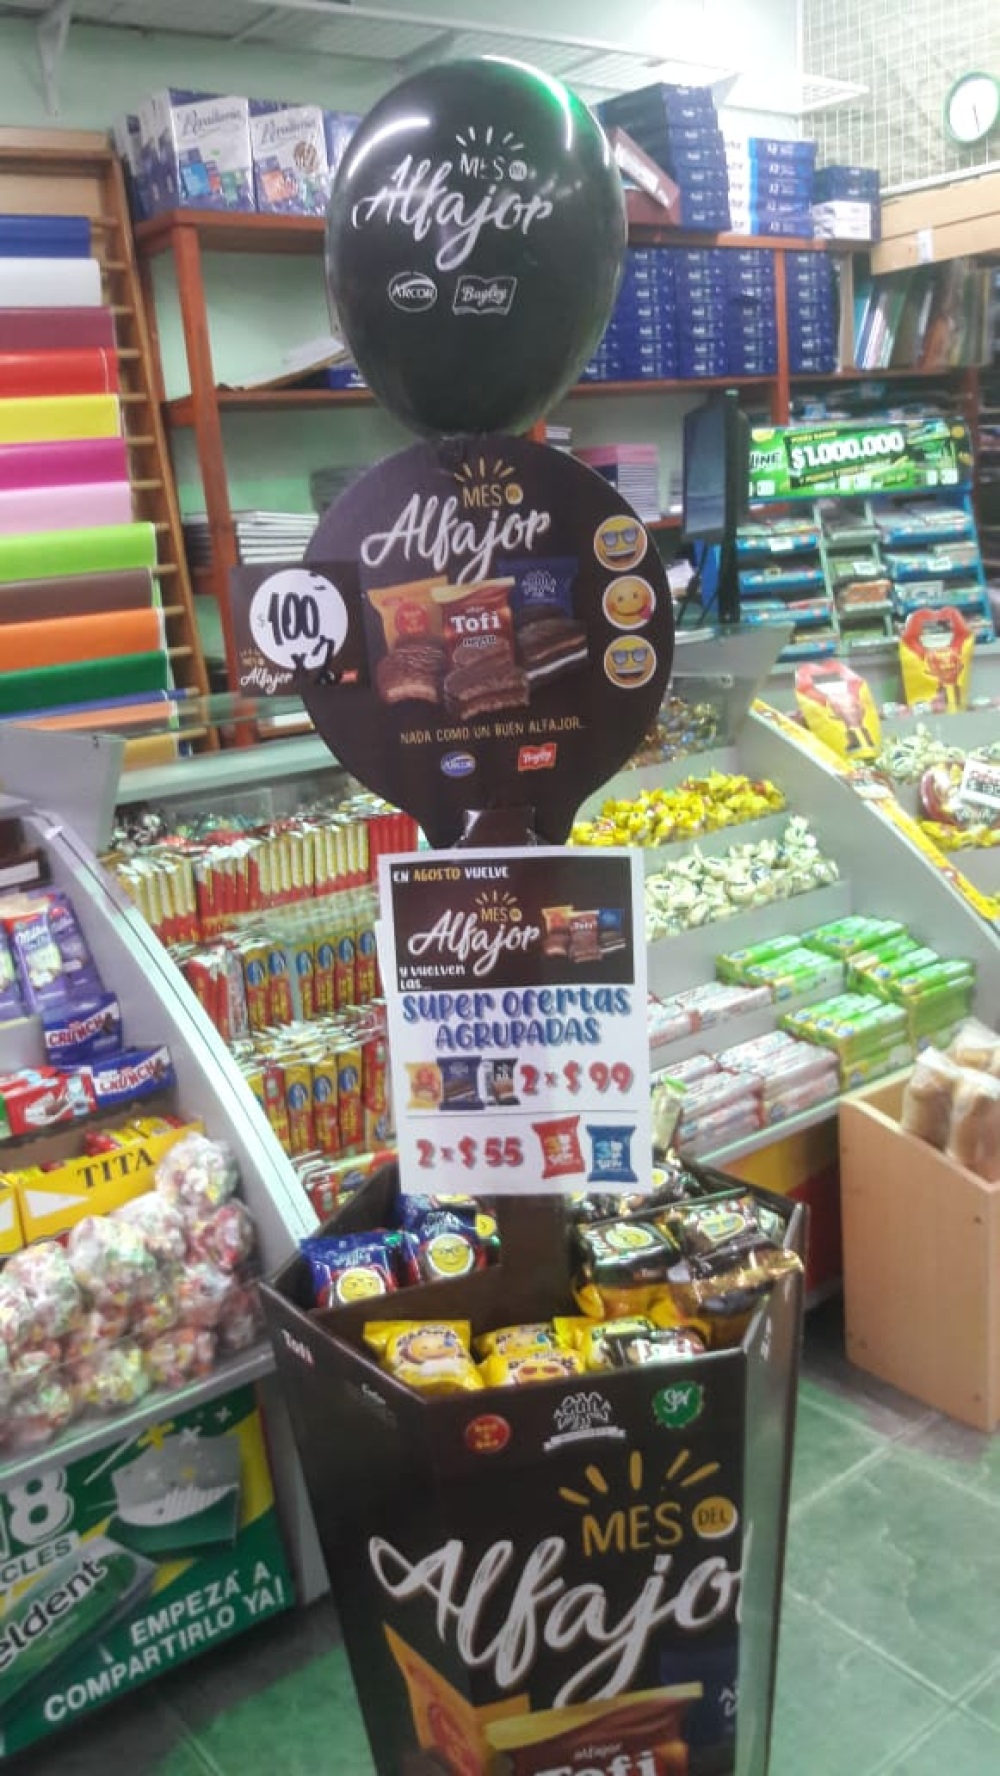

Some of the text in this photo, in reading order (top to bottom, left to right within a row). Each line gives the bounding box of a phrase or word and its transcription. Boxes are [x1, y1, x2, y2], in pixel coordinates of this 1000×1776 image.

[352, 153, 553, 271] Alfajor
[791, 431, 905, 469] $1.000.000
[463, 483, 502, 508] MES
[361, 493, 551, 587] Alfajor
[450, 610, 501, 634] Tofi
[400, 729, 431, 744] NADA
[436, 727, 469, 742] COMO
[474, 726, 490, 739] UN
[495, 722, 524, 737] BUEN
[394, 866, 509, 883] EN AGOSTO VUELVE
[481, 907, 508, 922] MES
[408, 908, 540, 977] Alfajor
[49, 1013, 107, 1046] CRUNCH
[435, 1017, 601, 1050] AGRUPADAS
[100, 1062, 156, 1092] CRUNCH
[76, 1147, 156, 1189] TITA
[582, 1501, 729, 1557] MES DEL
[253, 1560, 271, 1585] A
[43, 1575, 286, 1722] COMPARTIRLO YA!
